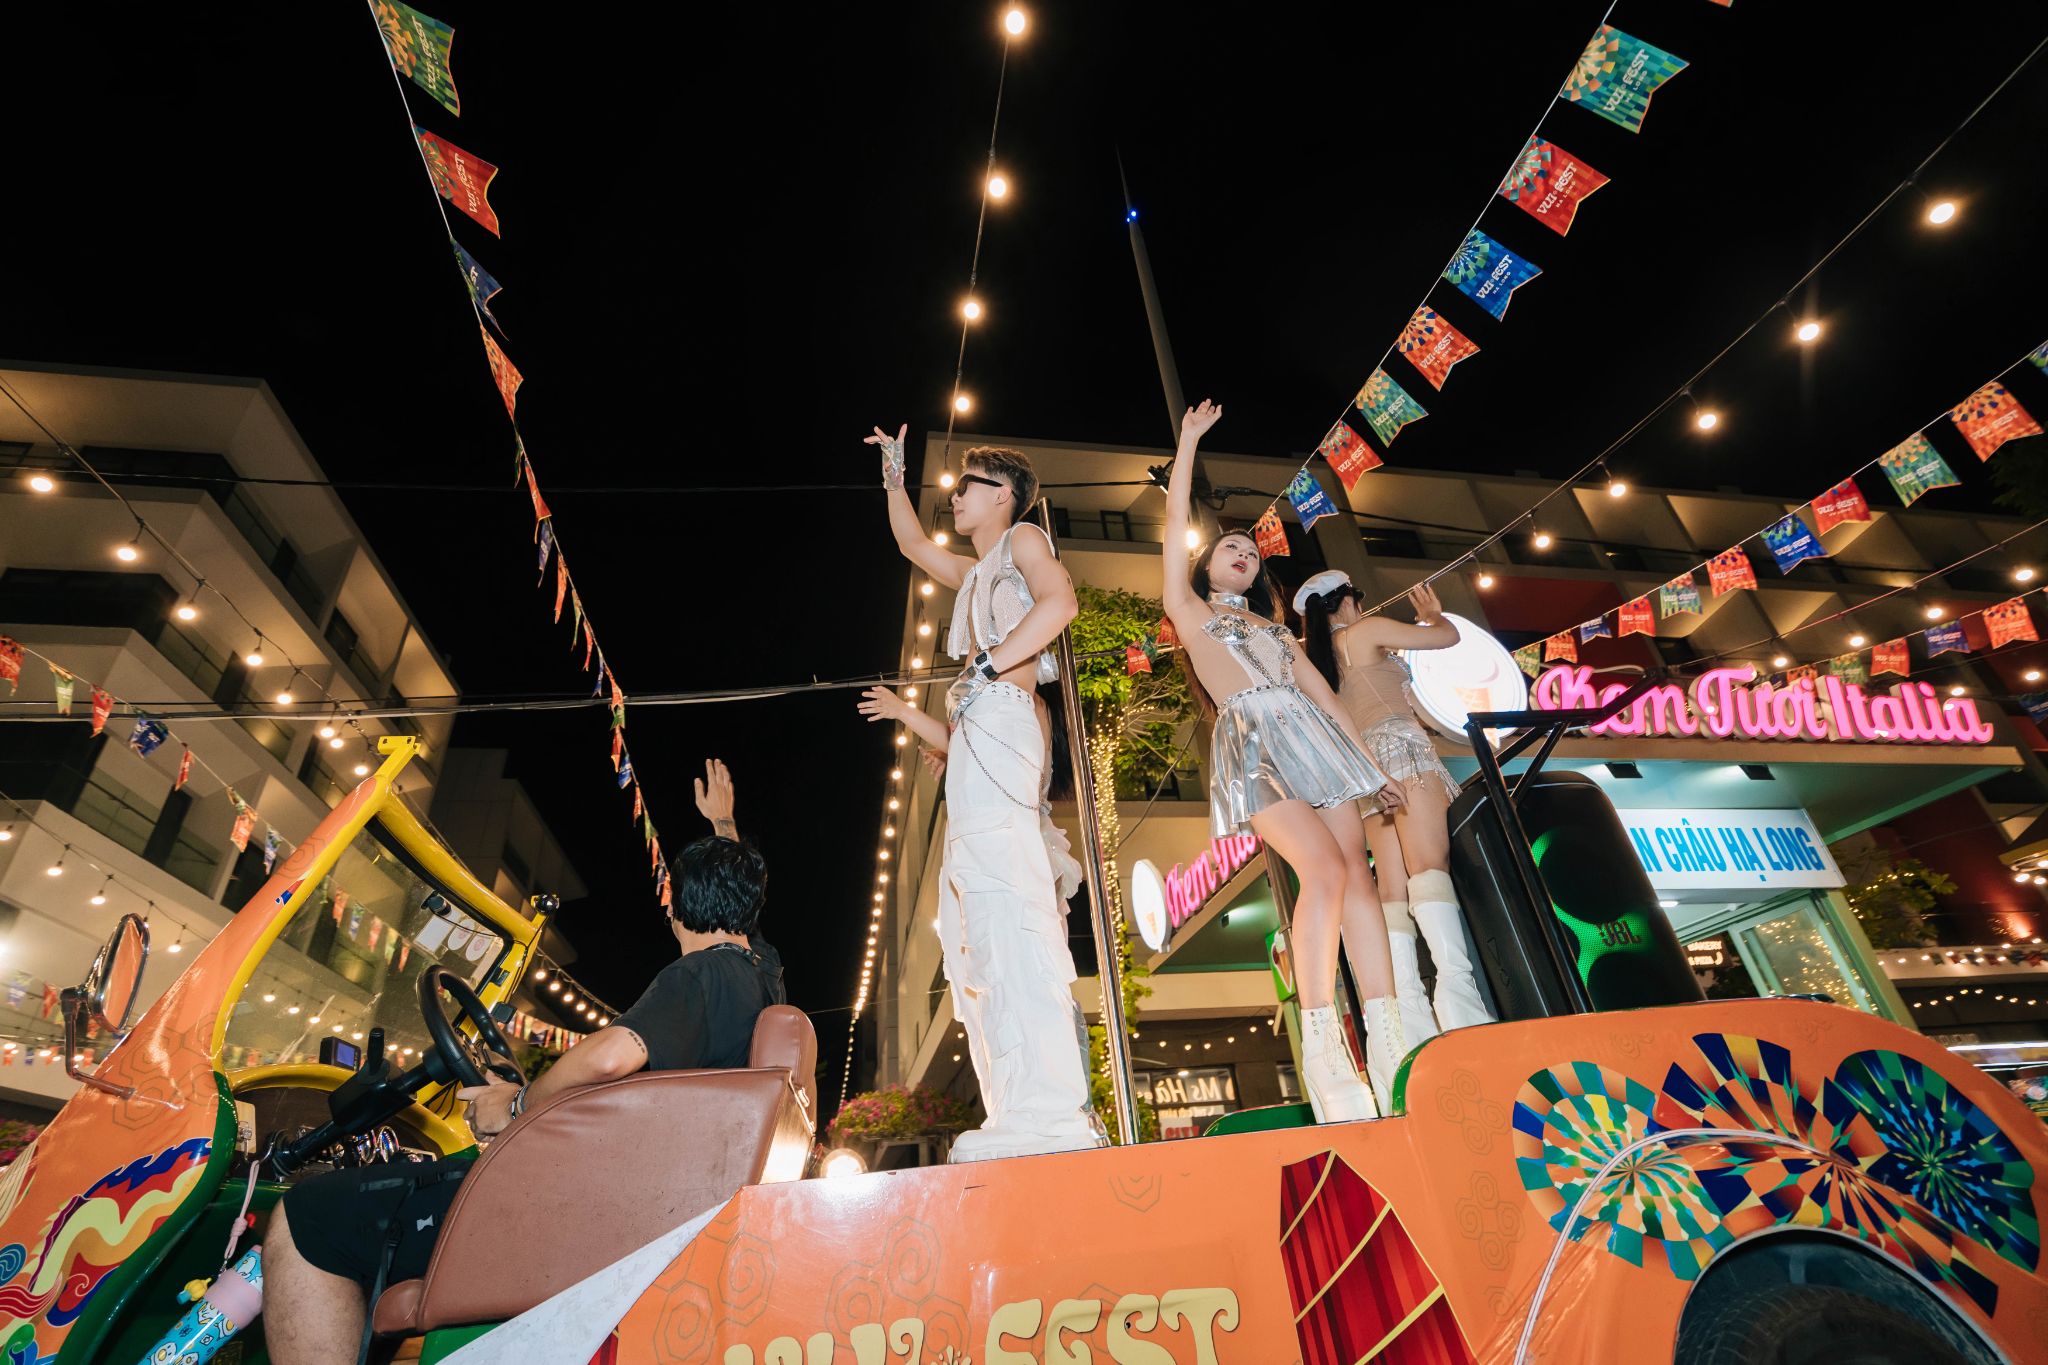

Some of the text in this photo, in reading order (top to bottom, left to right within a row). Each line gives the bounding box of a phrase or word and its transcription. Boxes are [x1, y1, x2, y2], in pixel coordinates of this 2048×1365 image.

[1603, 49, 1649, 112] VUI FEST
[1536, 162, 1577, 214] VUI FEST
[1476, 254, 1512, 299] VUI FEST
[1825, 674, 1995, 746] Italia
[1655, 818, 1727, 872] CHÂU
[1718, 827, 1767, 882] HẠ
[1752, 827, 1827, 872] LONG
[1600, 919, 1641, 947] JBL
